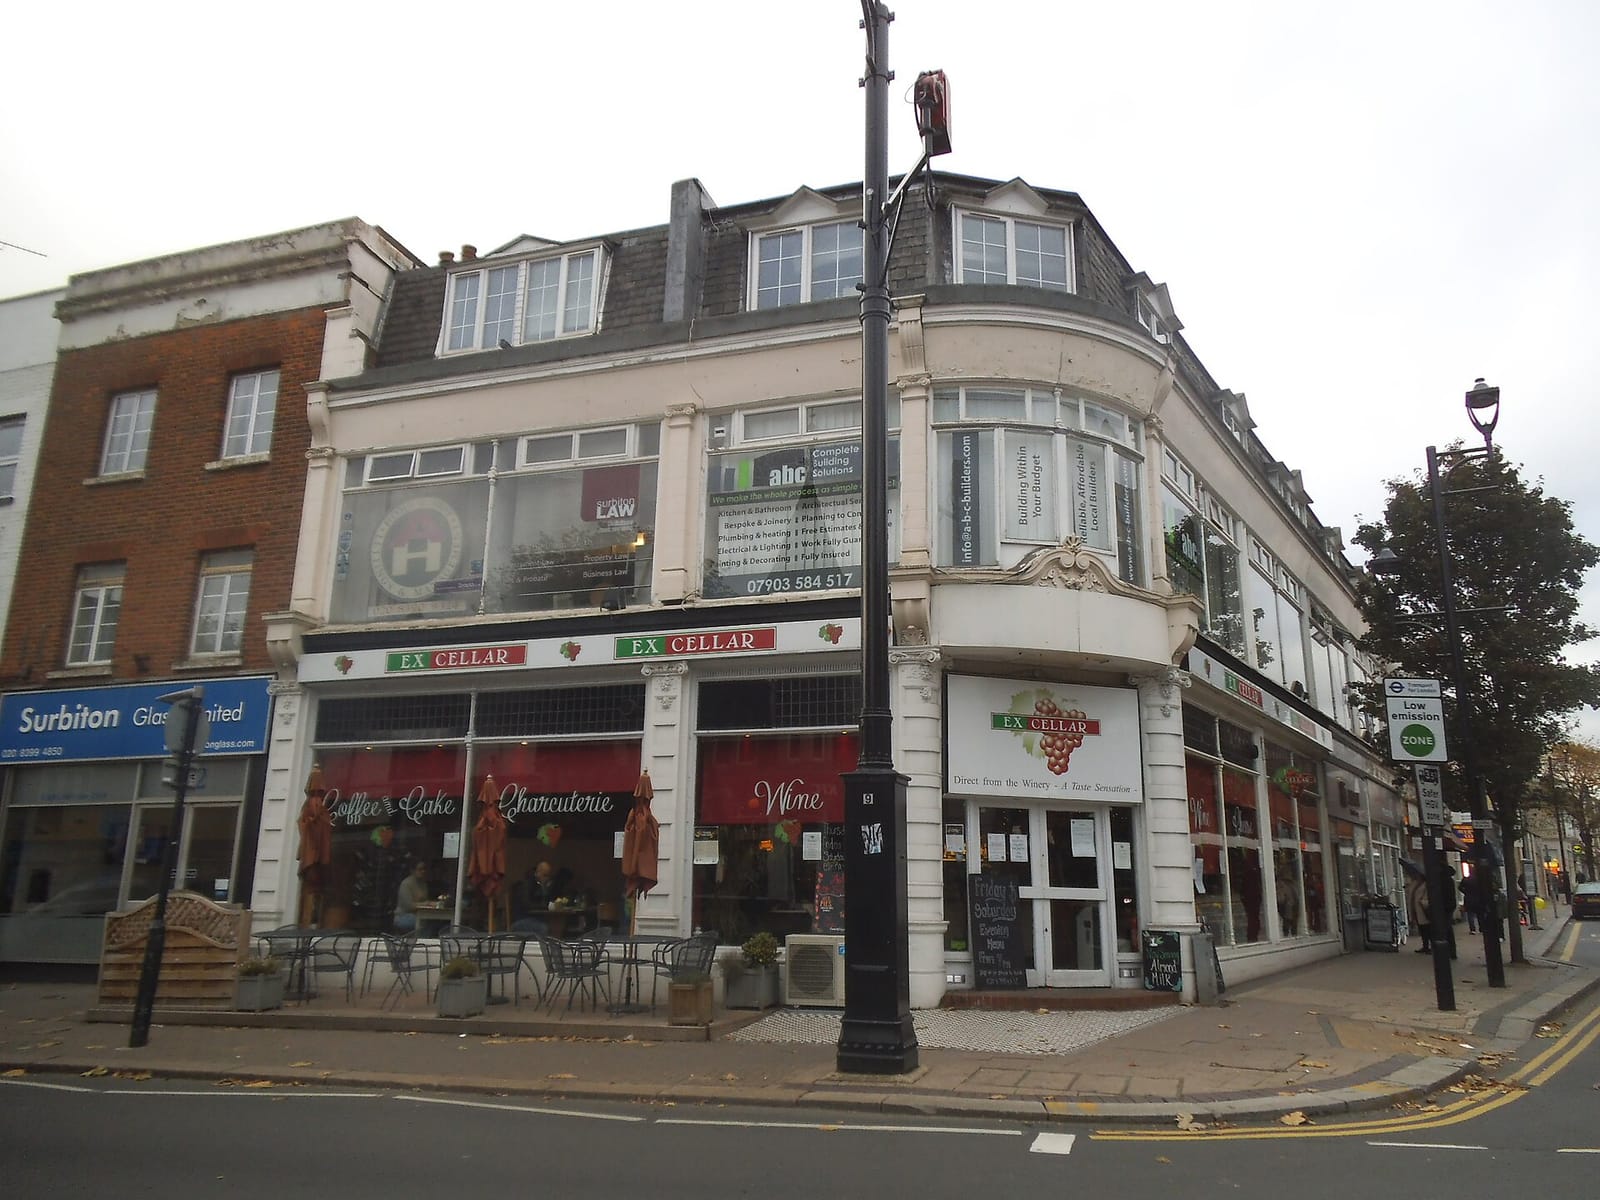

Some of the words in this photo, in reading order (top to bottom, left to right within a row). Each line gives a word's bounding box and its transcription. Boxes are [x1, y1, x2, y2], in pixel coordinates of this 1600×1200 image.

[812, 445, 860, 458] Complete
[812, 457, 850, 468] Building
[1017, 446, 1027, 480] Within
[1074, 443, 1086, 499] Affordable
[769, 464, 807, 487] abc
[812, 466, 854, 478] Solutions
[1032, 454, 1043, 493] Budget
[1089, 461, 1098, 505] Builders
[712, 496, 723, 504] We
[726, 494, 749, 502] make
[750, 492, 762, 500] the
[764, 490, 787, 498] whole
[788, 486, 819, 497] process
[832, 483, 858, 494] simple
[961, 436, 972, 562] info@a-b-c-builders.com
[596, 497, 636, 508] surbiton
[1018, 482, 1029, 526] Building
[1033, 494, 1042, 518] Your
[596, 504, 636, 520] LAW
[718, 508, 746, 518] Kitchen
[754, 505, 792, 514] Bathroom
[802, 512, 835, 523] Planning
[837, 511, 845, 519] to
[1090, 508, 1100, 531] Local
[724, 520, 756, 530] Bespoke
[764, 517, 792, 526] Joinery
[802, 526, 818, 535] Free
[820, 524, 857, 534] Estimates
[718, 532, 754, 542] Plumbing
[762, 530, 791, 538] heating
[801, 538, 820, 548] Work
[822, 536, 841, 547] Fully
[718, 546, 751, 554] Electrical
[760, 543, 791, 552] Lighting
[801, 552, 820, 562] Fully
[820, 550, 851, 559] Insured
[750, 554, 791, 564] Decorating
[583, 570, 612, 578] Business
[747, 578, 791, 593] 07903
[795, 575, 822, 590] 584
[826, 572, 853, 587] 517
[632, 639, 658, 655] EX
[671, 632, 755, 652] CELLAR
[401, 654, 424, 669] EX
[435, 649, 508, 666] CELLAR
[1404, 700, 1426, 710] Low
[18, 704, 120, 733] Surbiton
[132, 706, 168, 726] Glas
[1004, 716, 1024, 729] EX
[1031, 719, 1088, 734] CELLAR
[1392, 712, 1440, 721] emission
[1402, 736, 1434, 745] ZONE
[2, 749, 17, 758] 020
[42, 746, 63, 756] 4850
[954, 775, 979, 785] Direct
[982, 776, 1002, 787] from
[1006, 778, 1018, 788] the
[1022, 779, 1051, 791] Winery
[1061, 782, 1068, 790] A
[1072, 782, 1092, 791] Taste
[1094, 783, 1131, 793] Sensation
[498, 782, 614, 824] Charcuterie
[754, 778, 824, 816] Wine
[864, 794, 872, 804] 9
[322, 788, 382, 827] Coffee
[382, 795, 398, 817] and
[398, 785, 456, 825] Cake
[974, 878, 1006, 899] Friday
[974, 902, 1017, 921] Saturday
[1152, 972, 1174, 987] Milk
